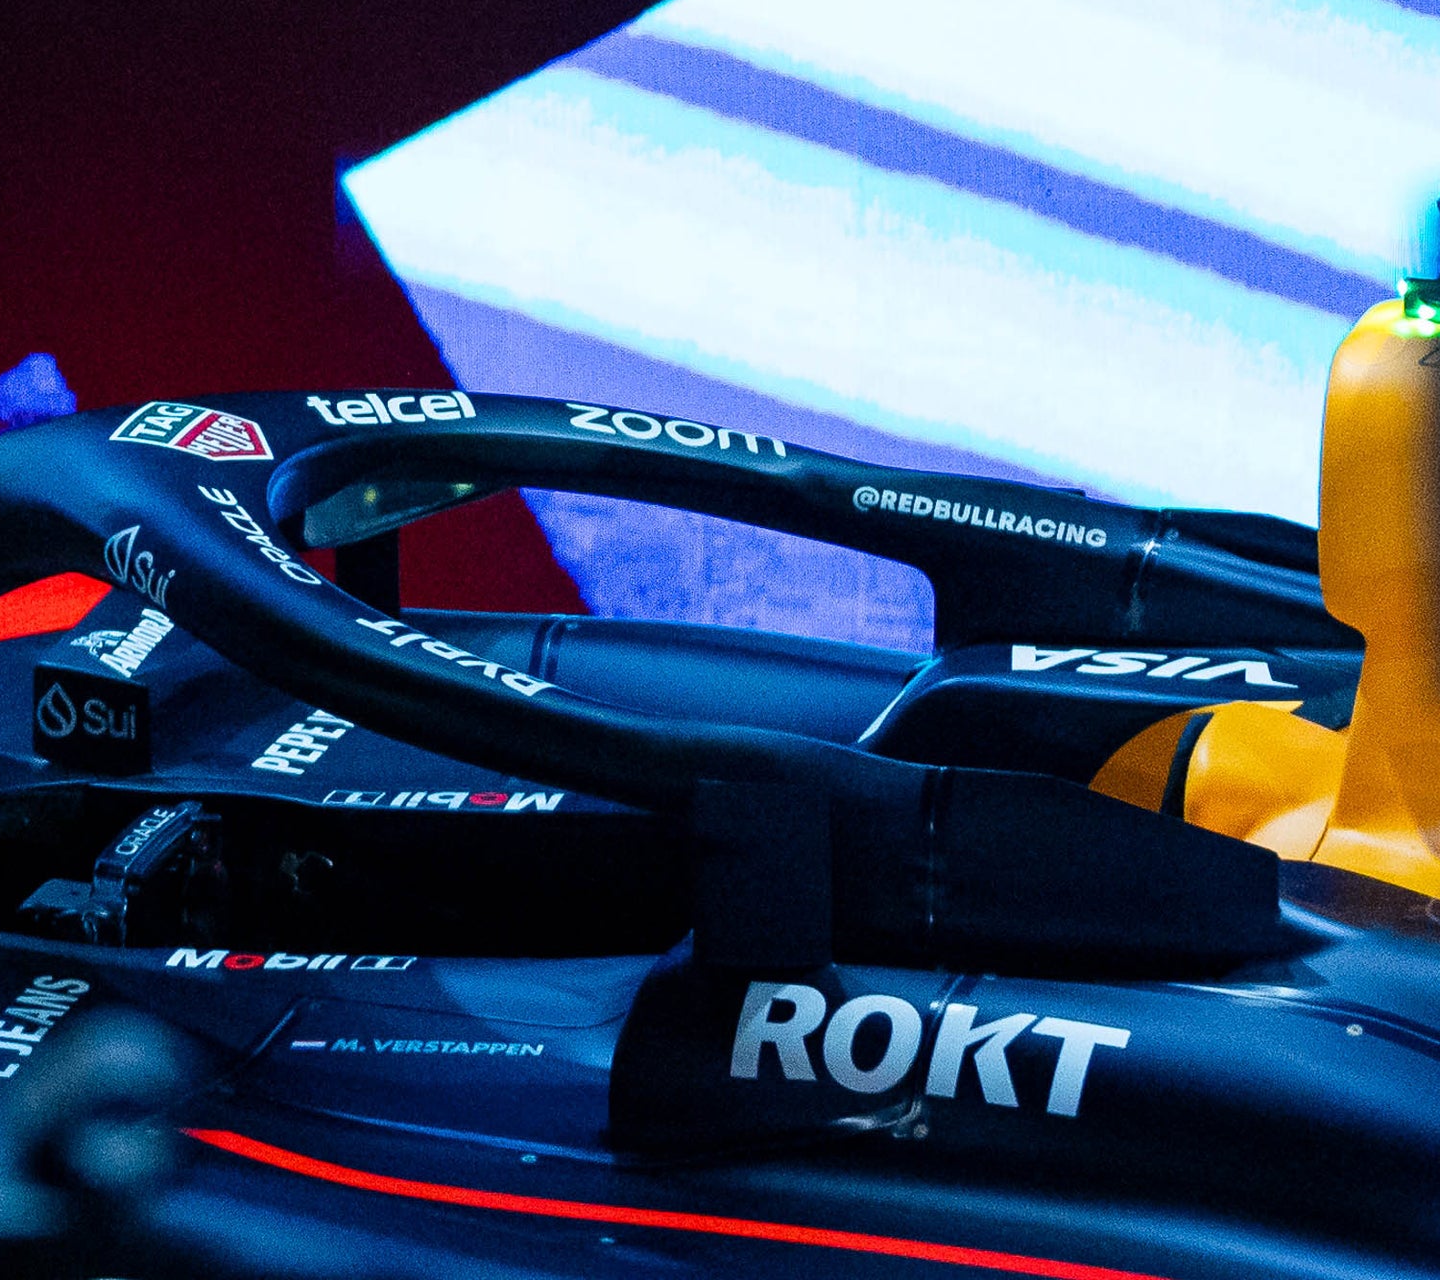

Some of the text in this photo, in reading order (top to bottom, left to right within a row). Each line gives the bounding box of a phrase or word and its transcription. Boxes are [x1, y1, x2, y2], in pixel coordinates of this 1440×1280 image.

[129, 404, 256, 454] TAG HEUER
[307, 391, 787, 458] telcel zoom
[197, 484, 323, 585] ORACLE
[852, 485, 1108, 549] @REDBULLRACING
[132, 550, 176, 609] Sui
[355, 617, 556, 698] BYBIT
[1012, 644, 1299, 690] VISA
[83, 698, 137, 740] Sui
[251, 713, 349, 775] PEPE
[389, 791, 565, 812] Mobil
[166, 947, 347, 971] Mobil
[330, 1038, 544, 1057] M. VERSTAPPEN
[730, 981, 1132, 1117] ROKT
